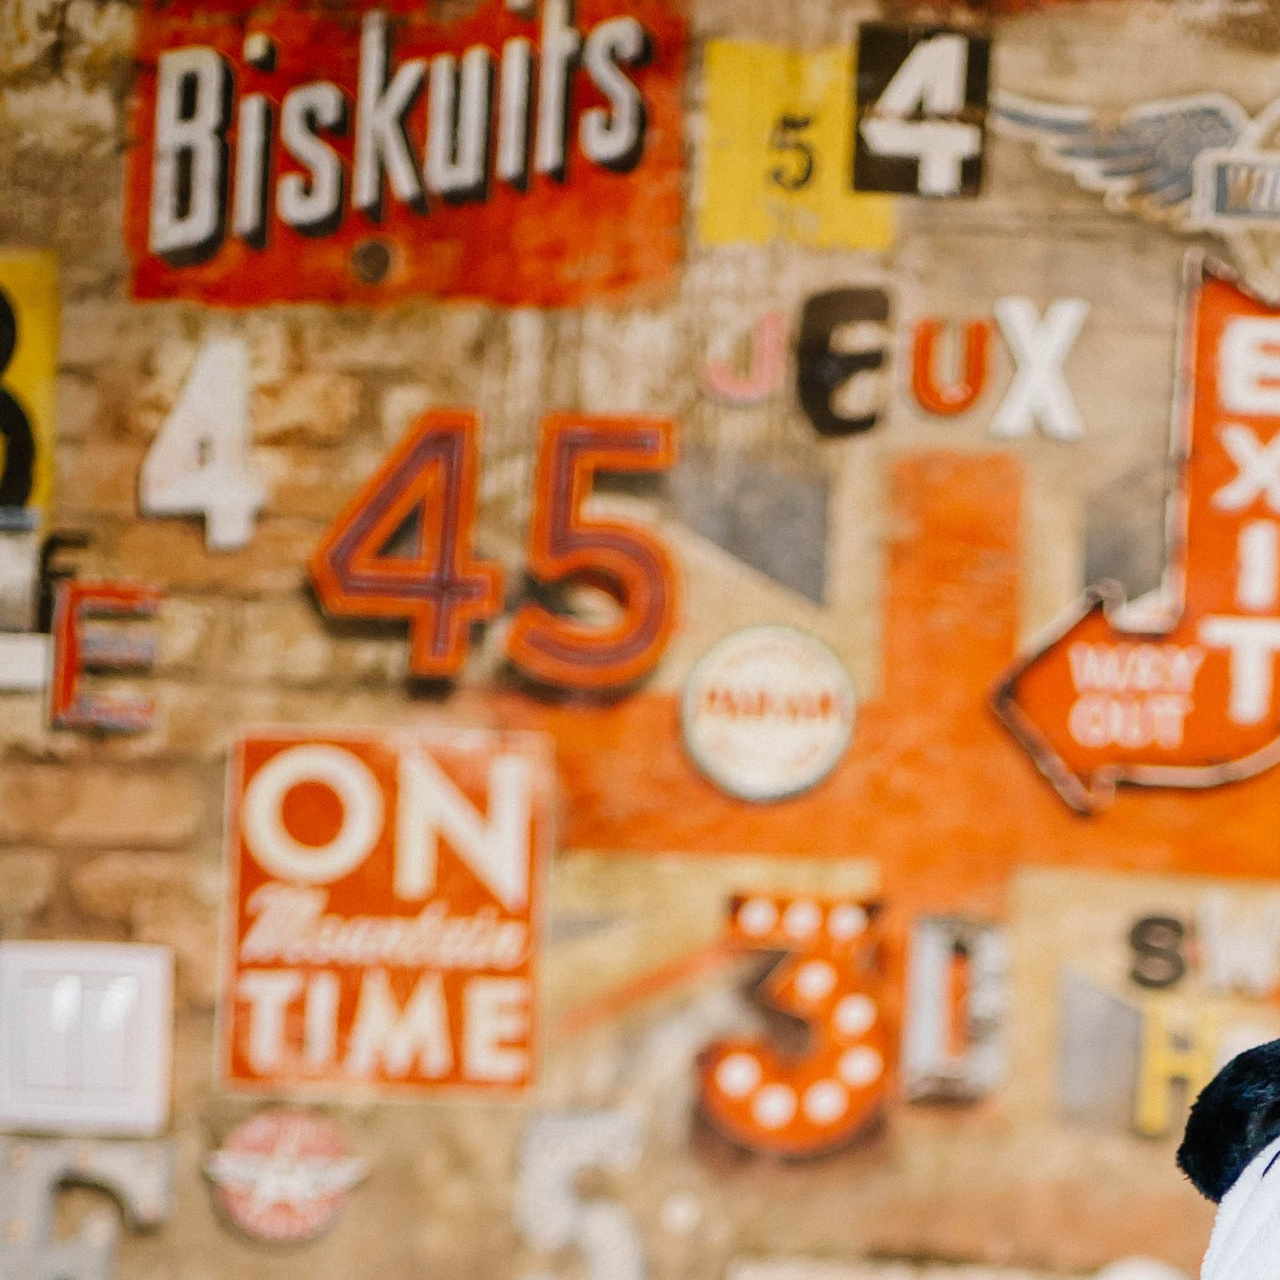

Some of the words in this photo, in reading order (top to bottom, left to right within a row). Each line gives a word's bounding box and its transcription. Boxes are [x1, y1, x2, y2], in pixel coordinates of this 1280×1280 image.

[148, 0, 655, 262] Biskuits
[768, 113, 815, 192] 5
[860, 32, 985, 196] 4
[139, 338, 263, 550] 4
[1068, 641, 1205, 693] WAY
[1068, 695, 1194, 748] OUT
[242, 743, 534, 910] ON
[238, 968, 531, 1083] TIME
[702, 896, 886, 1155] 3
